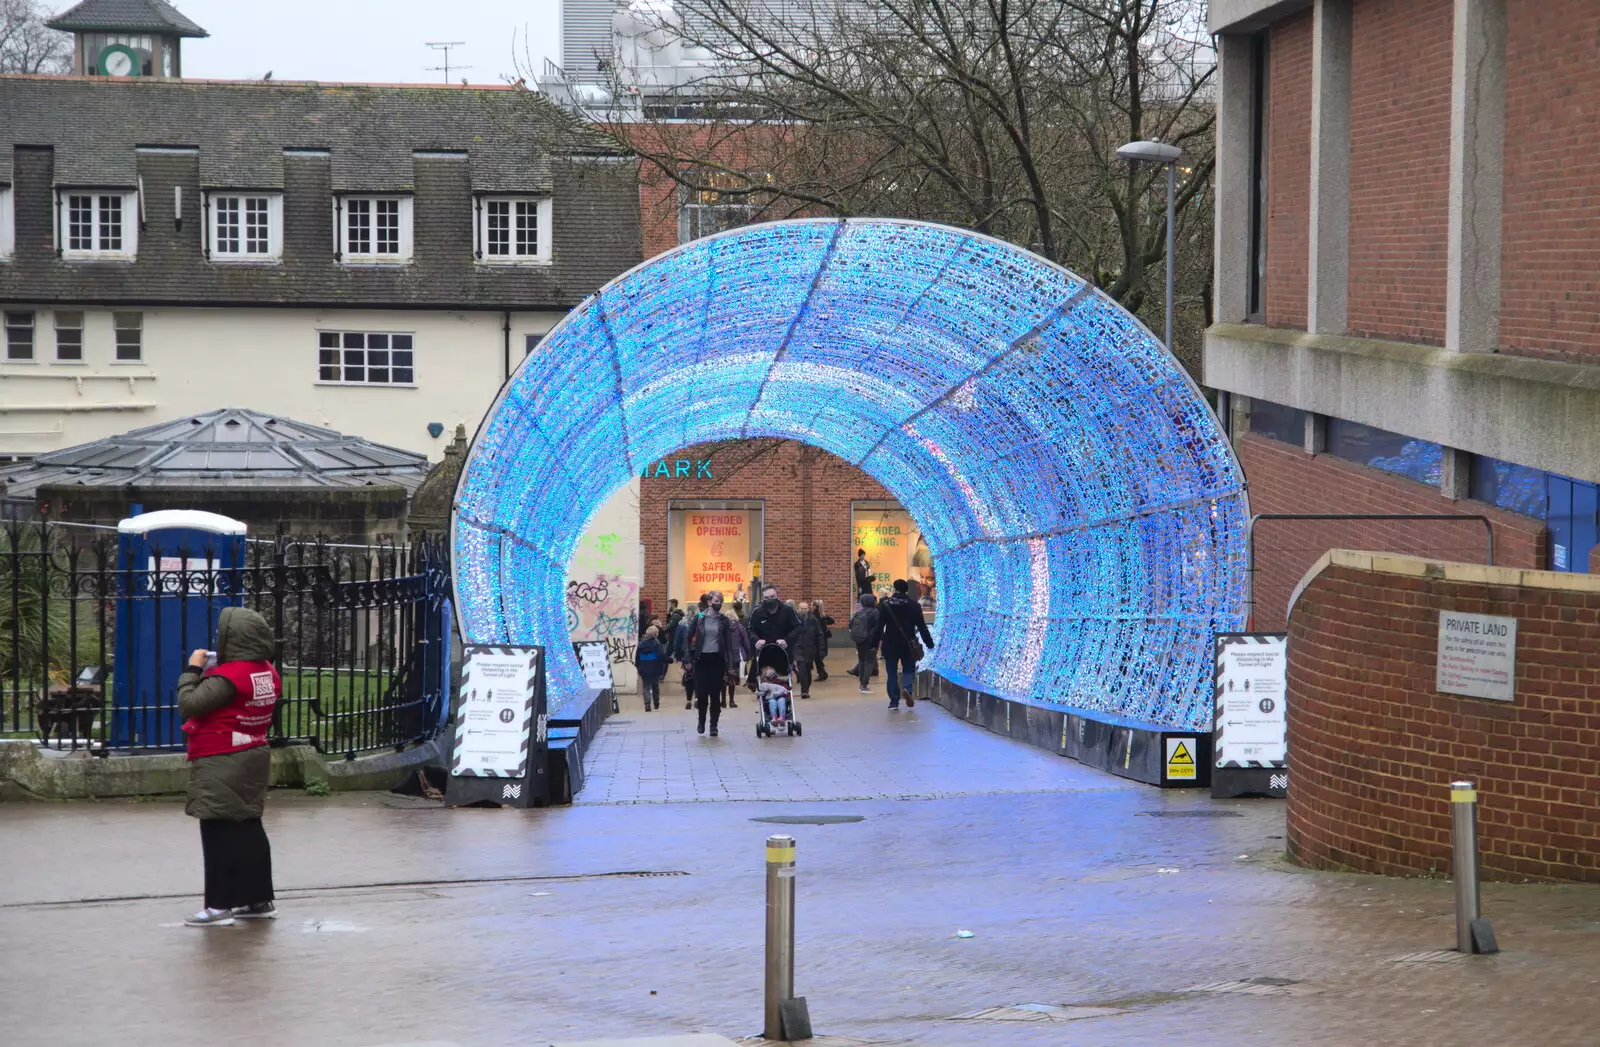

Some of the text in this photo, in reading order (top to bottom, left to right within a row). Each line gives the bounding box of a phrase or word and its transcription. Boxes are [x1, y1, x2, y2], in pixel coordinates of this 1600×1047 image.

[692, 515, 743, 525] EXTENDED
[696, 526, 741, 536] OPENING.
[702, 562, 733, 572] SAFER
[693, 573, 744, 583] SHOPPING.
[1446, 619, 1508, 637] PRIVATE LAND
[255, 684, 275, 696] ISSUE
